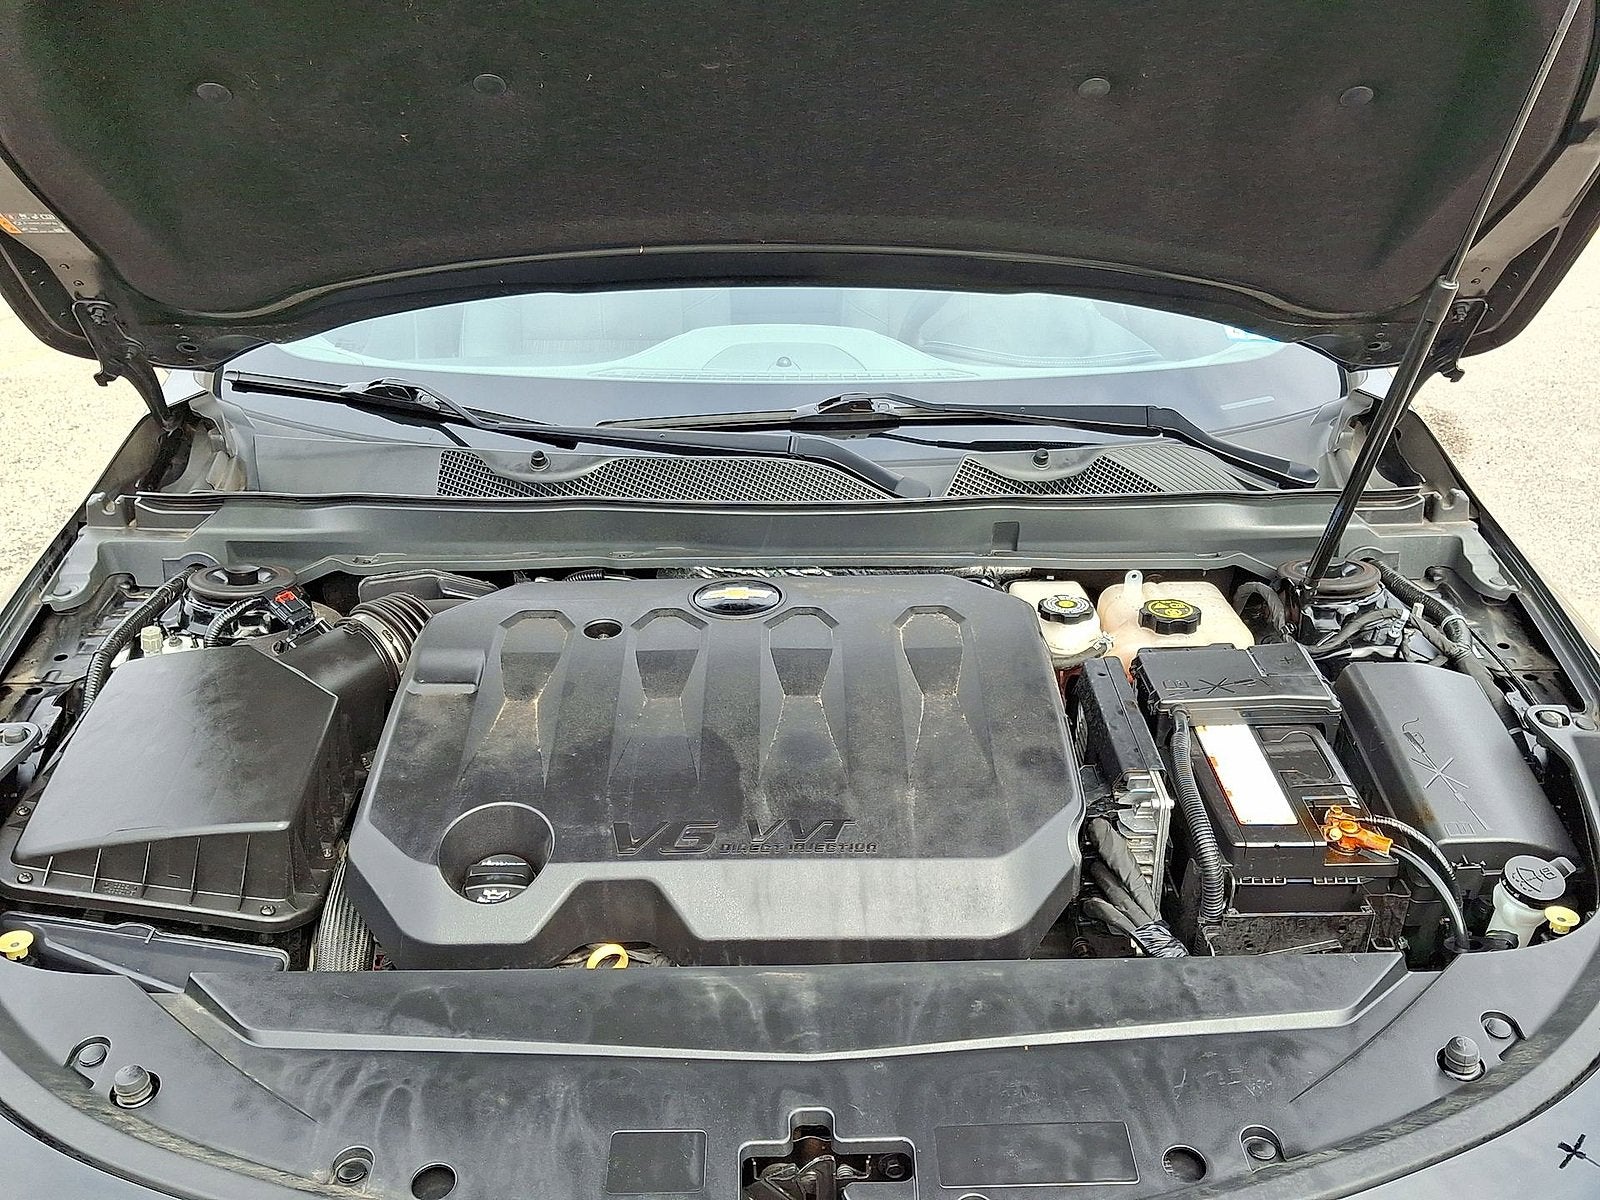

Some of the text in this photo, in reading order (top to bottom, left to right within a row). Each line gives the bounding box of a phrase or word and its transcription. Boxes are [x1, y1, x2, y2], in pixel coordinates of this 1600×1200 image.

[612, 817, 858, 856] V6 VVT
[719, 842, 878, 854] DIRECT INJECTION
